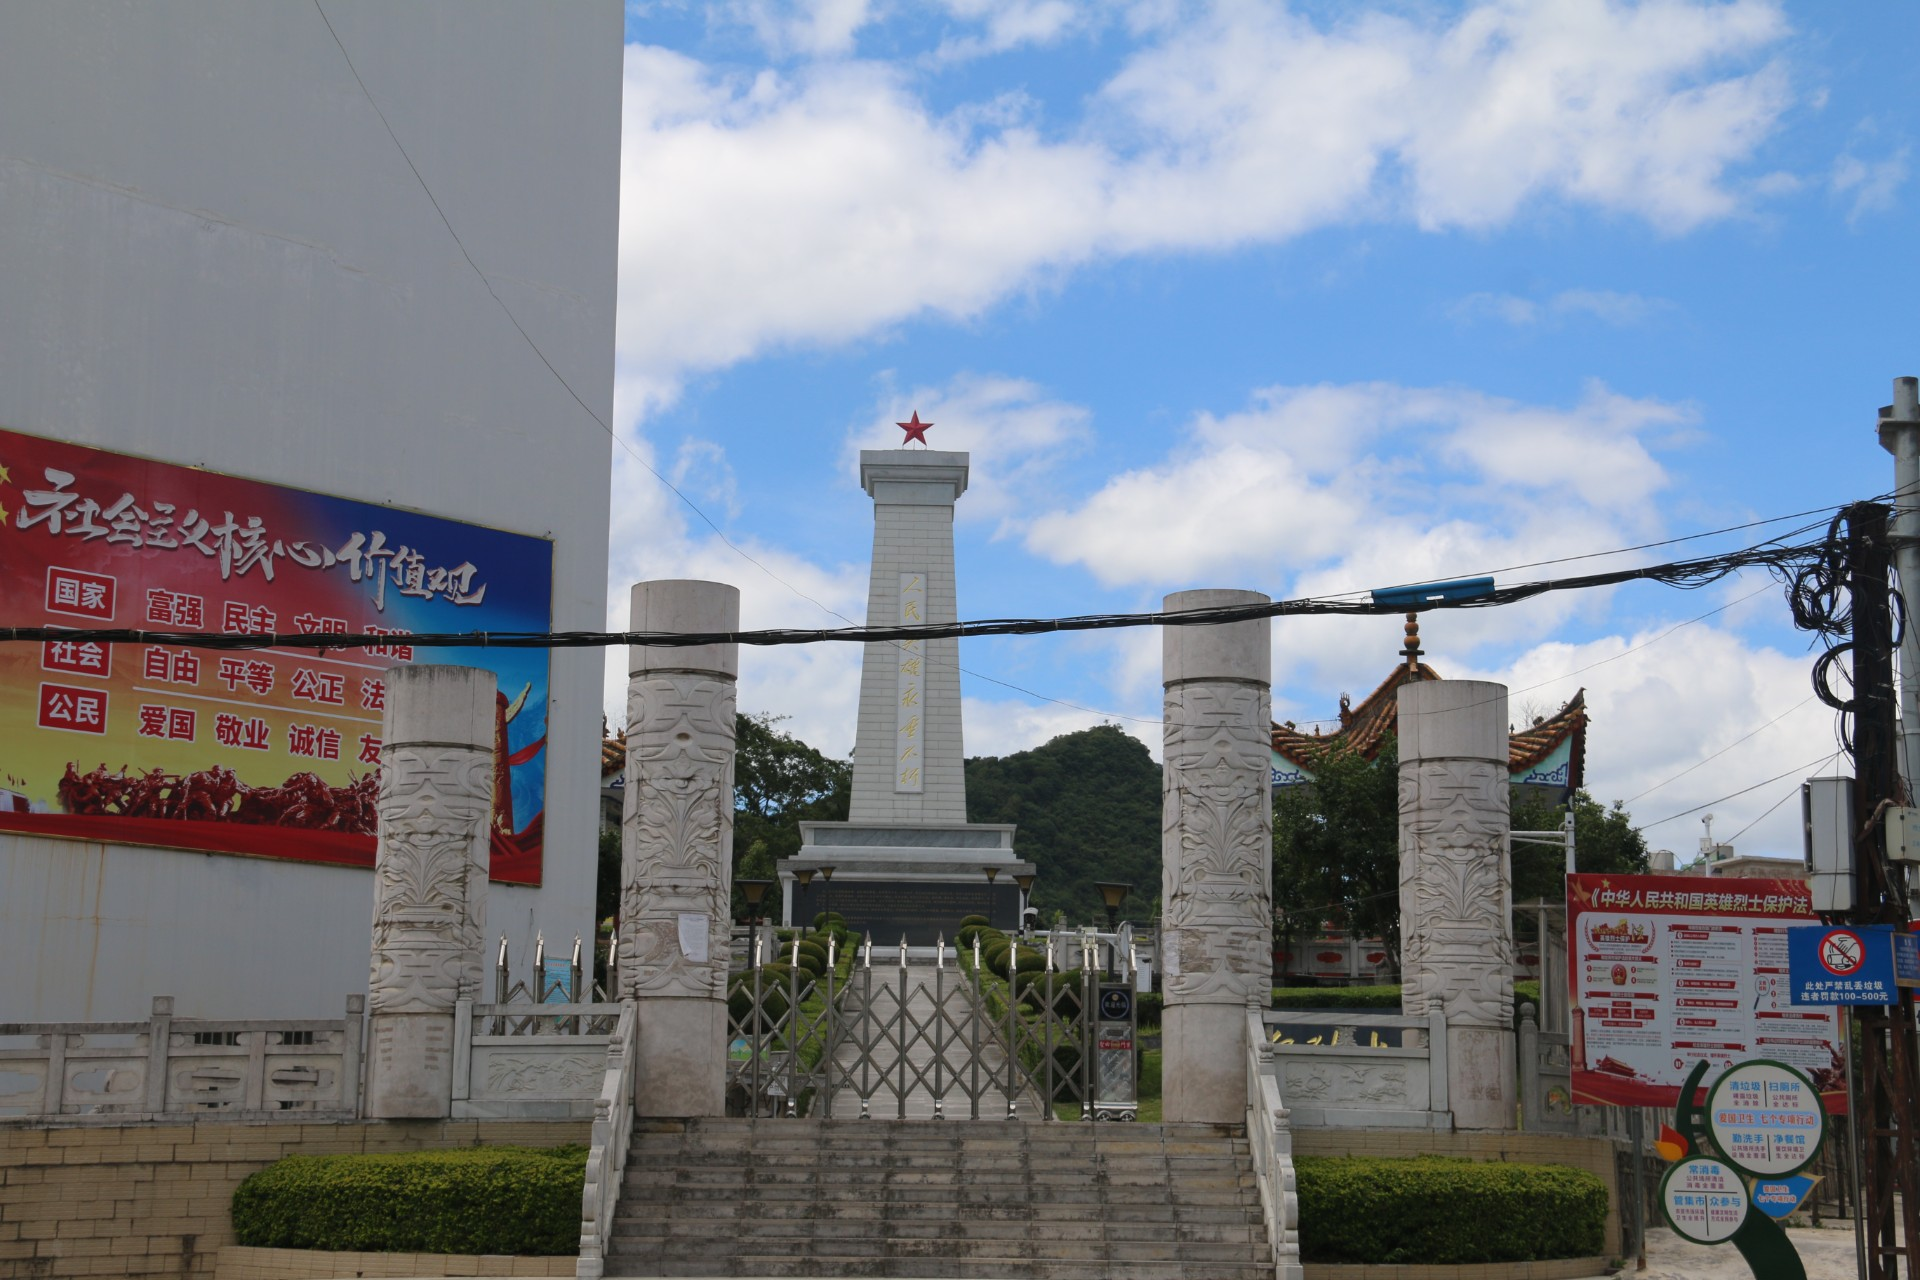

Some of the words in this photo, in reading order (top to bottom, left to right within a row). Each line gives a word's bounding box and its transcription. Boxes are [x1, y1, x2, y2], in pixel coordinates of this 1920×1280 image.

[15, 467, 487, 611] 社会主义核心价值观
[55, 577, 106, 610] 国家
[147, 588, 204, 629] 富强
[223, 601, 276, 635] 民主
[294, 613, 348, 651] 文明
[363, 624, 414, 662] 和谐
[50, 640, 104, 668] 社会
[144, 646, 200, 684] 自由
[219, 657, 275, 695] 平等
[292, 668, 345, 706] 公正
[361, 680, 385, 712] 法
[48, 693, 99, 725] 公民
[138, 704, 197, 742] 爱国
[215, 714, 271, 751] 敬业
[289, 724, 342, 760] 诚信
[358, 734, 383, 765] 友
[1805, 981, 1883, 991] 此处严禁乱丢垃圾
[1801, 992, 1888, 1001] 违者罚款100-500元
[1730, 1081, 1761, 1091] 清垃圾
[1768, 1082, 1800, 1092] 扫厕所
[1719, 1113, 1754, 1124] 爱国卫生
[1761, 1114, 1814, 1125] 七个专项行动
[1732, 1134, 1763, 1143] 勤洗手
[1773, 1134, 1805, 1144] 净餐馆
[1688, 1165, 1720, 1175] 常消毒
[1673, 1195, 1705, 1206] 管集市
[1709, 1196, 1741, 1207] 众参与
